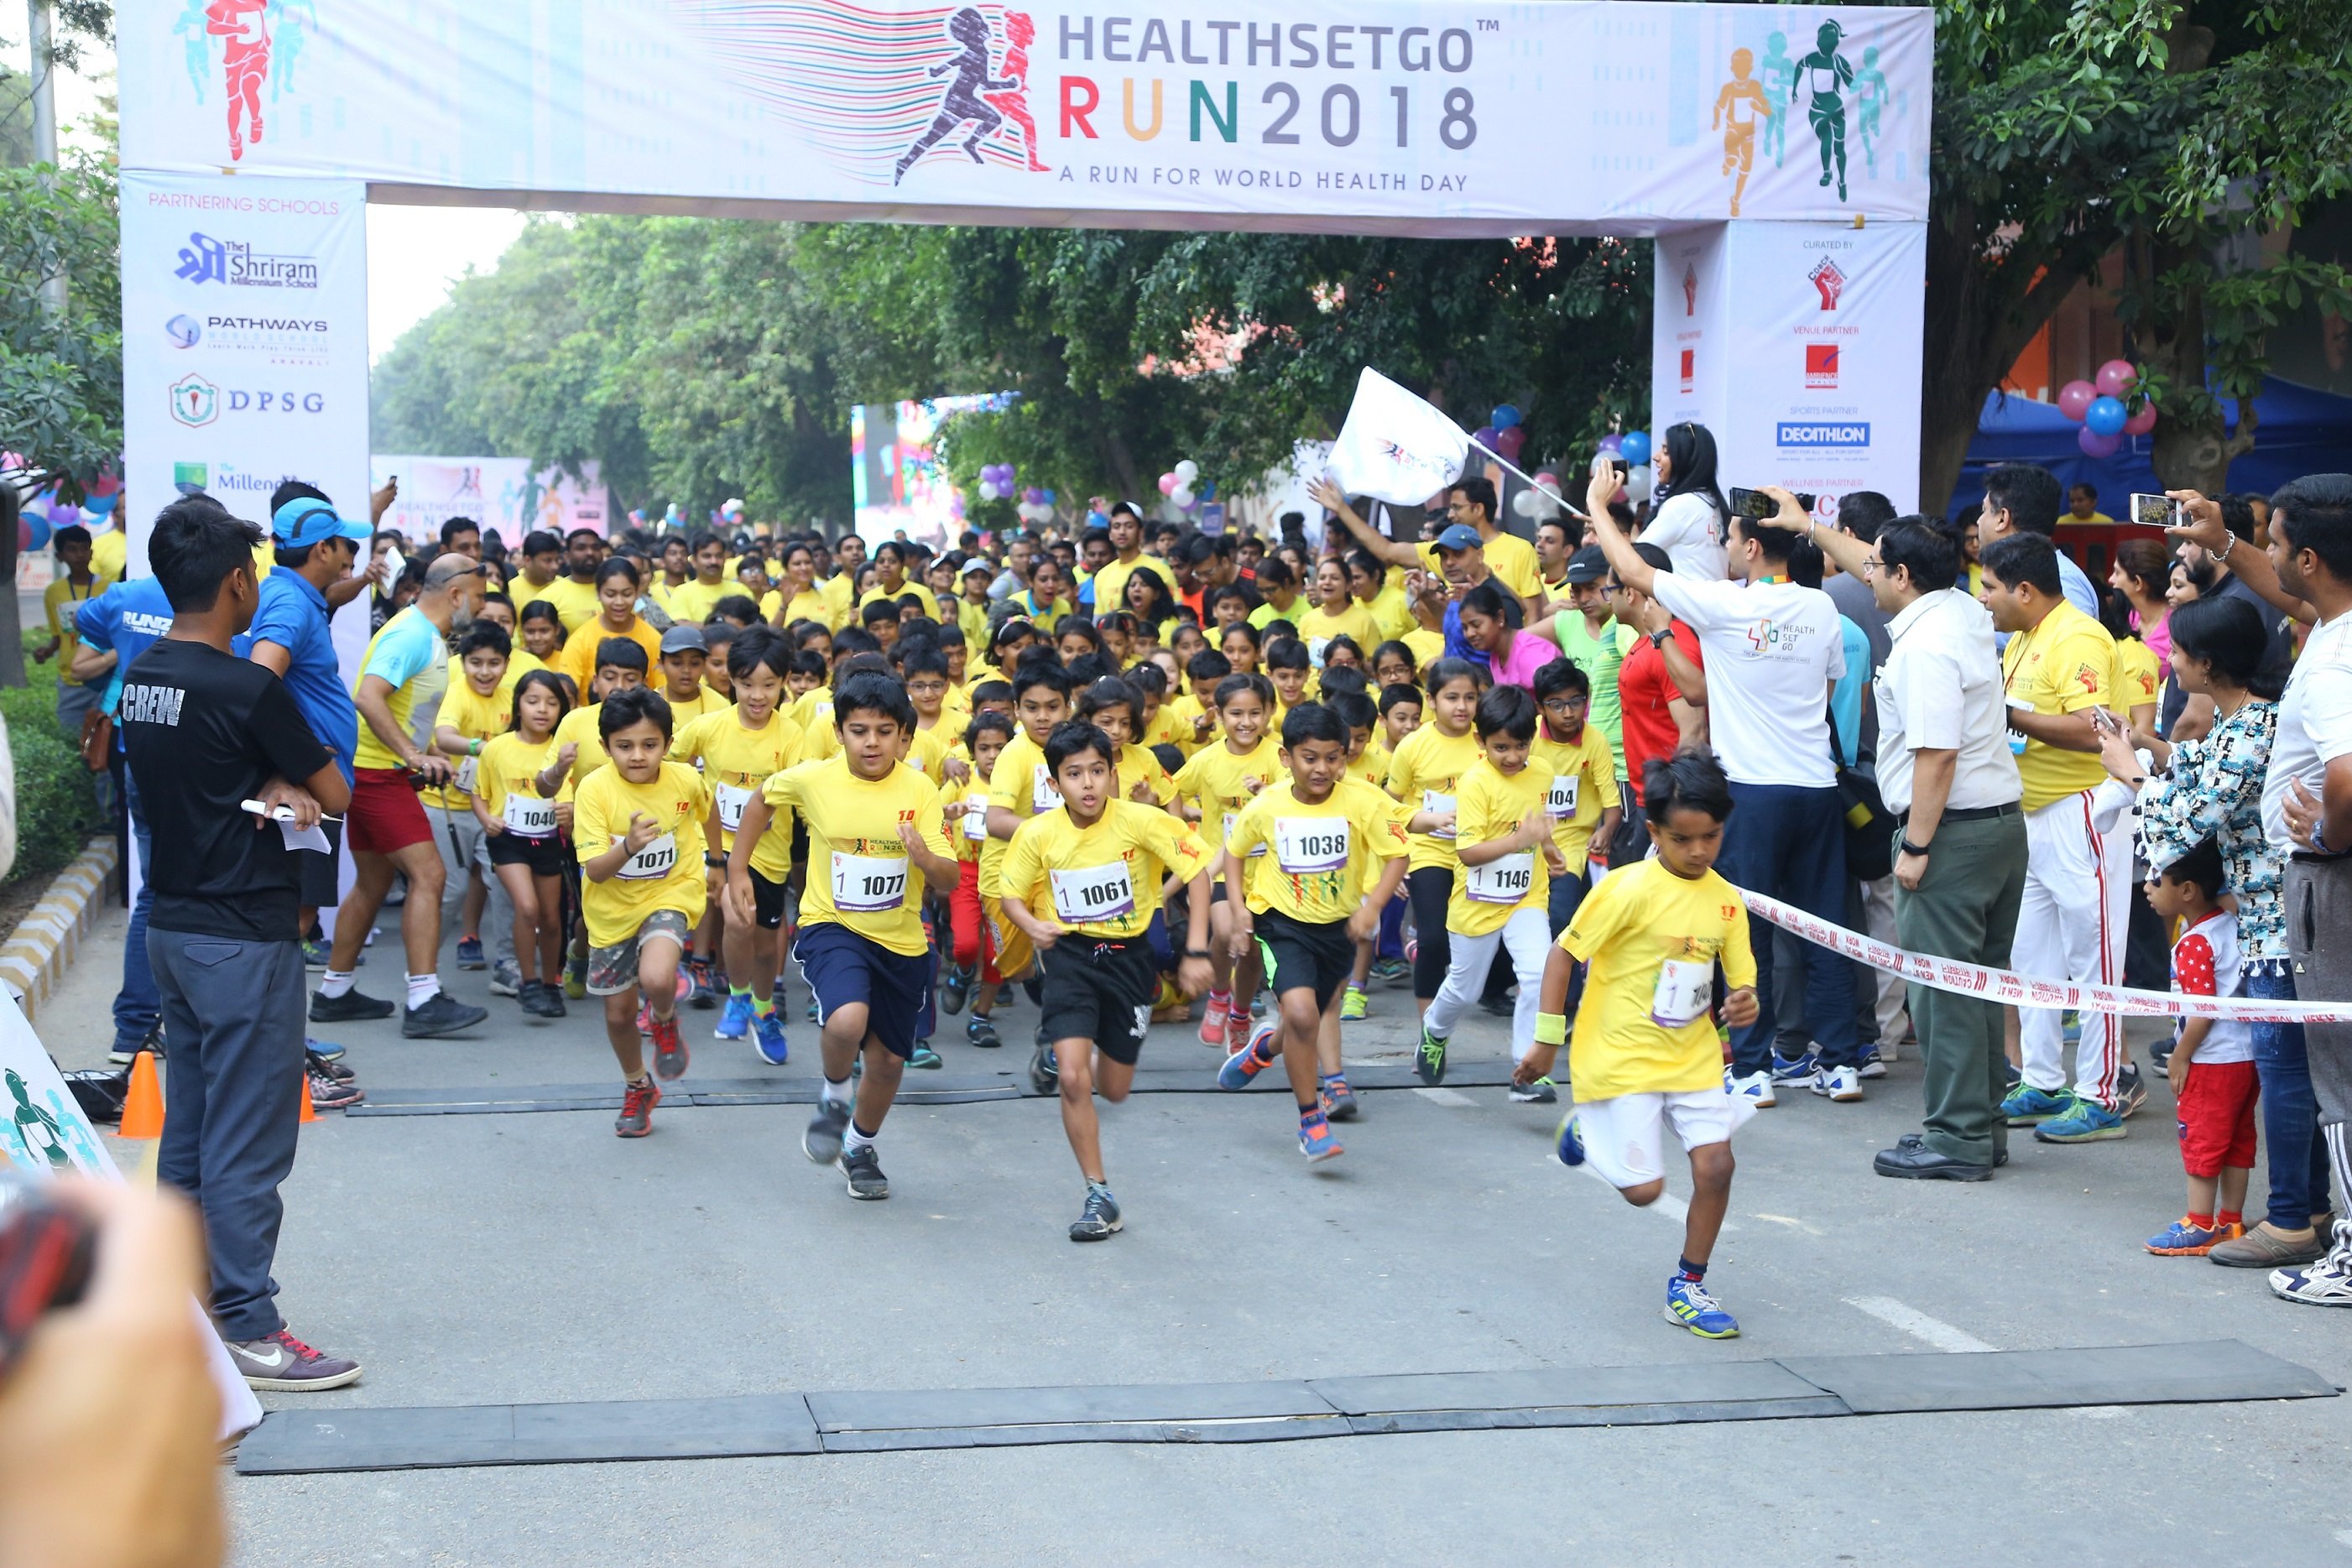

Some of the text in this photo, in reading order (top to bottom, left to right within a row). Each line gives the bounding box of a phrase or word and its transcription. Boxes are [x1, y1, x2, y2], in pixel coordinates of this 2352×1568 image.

[1059, 15, 1473, 73] HEALTHSETGO
[1059, 165, 1468, 192] A RUN FOR WORLD HEALTH DAY
[149, 192, 339, 215] PARTNERING SCHOOLS
[225, 241, 244, 252] The
[1803, 241, 1854, 249] CURATED BY
[230, 242, 317, 279] Shriram
[230, 277, 317, 289] Millennium School
[208, 317, 327, 331] PATHWAYS
[1794, 326, 1859, 335] VENUE PARTNER
[1790, 407, 1859, 415] SPORTS PARTNER
[1781, 427, 1864, 442] DECATHLON
[1782, 479, 1823, 487] WELLNESS
[1783, 623, 1815, 635] HEALTH
[1783, 633, 1798, 643] SET
[1782, 643, 1793, 651] GO
[123, 684, 185, 727] CREW
[1040, 780, 1047, 800] 1
[721, 800, 727, 815] 1
[509, 808, 516, 823] 1
[524, 811, 557, 826] 1040
[1282, 836, 1290, 857] 1
[1299, 835, 1345, 856] 1038
[636, 847, 673, 868] 1071
[836, 872, 845, 893] 1
[863, 873, 905, 895] 1077
[1474, 867, 1482, 886] 1
[1495, 870, 1530, 888] 1146
[1059, 888, 1069, 908] 1
[1080, 878, 1129, 907] 1061
[1846, 935, 1859, 947] WORK
[1913, 956, 1932, 969] WORK
[1913, 967, 1936, 982] MEN AT
[1943, 974, 1972, 988] CAUTION
[1998, 973, 2021, 986] WORK
[1667, 982, 1677, 1008] 1
[1997, 985, 2023, 998] MEN AT
[2031, 991, 2064, 1005] CAUTION
[2091, 989, 2116, 1002] WORK
[2193, 1003, 2219, 1012] WORK
